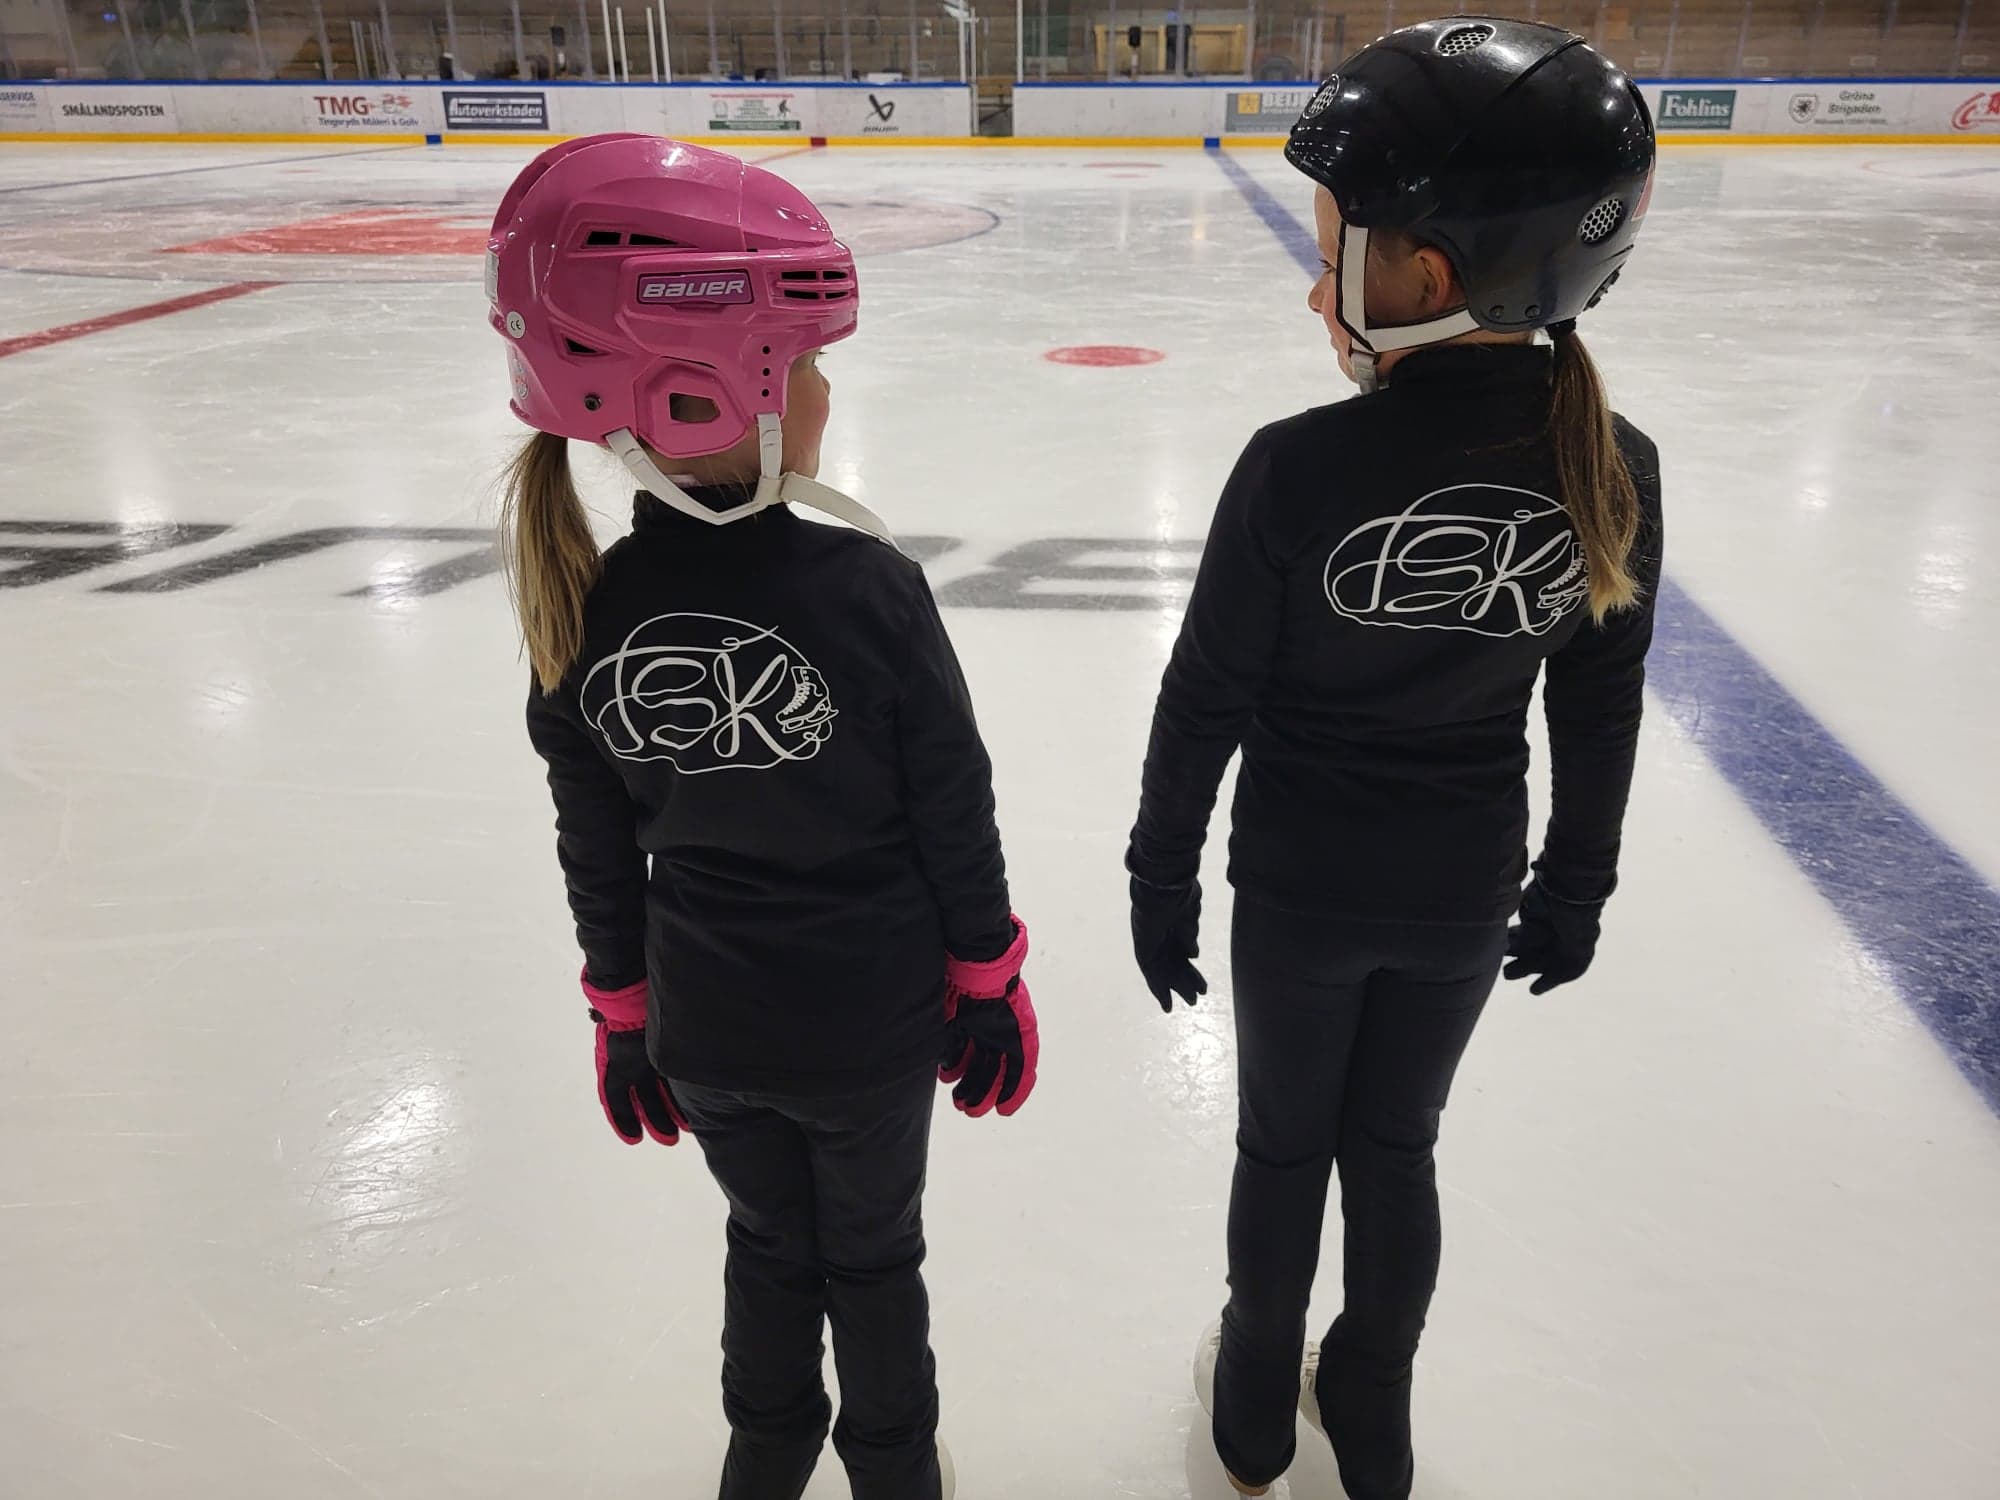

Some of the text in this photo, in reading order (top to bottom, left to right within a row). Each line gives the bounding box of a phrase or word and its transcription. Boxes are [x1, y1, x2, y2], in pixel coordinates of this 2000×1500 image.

[62, 102, 165, 117] SMÅLANDSPOSTEN
[313, 96, 369, 116] TMG
[1663, 95, 1730, 118] Fohlins
